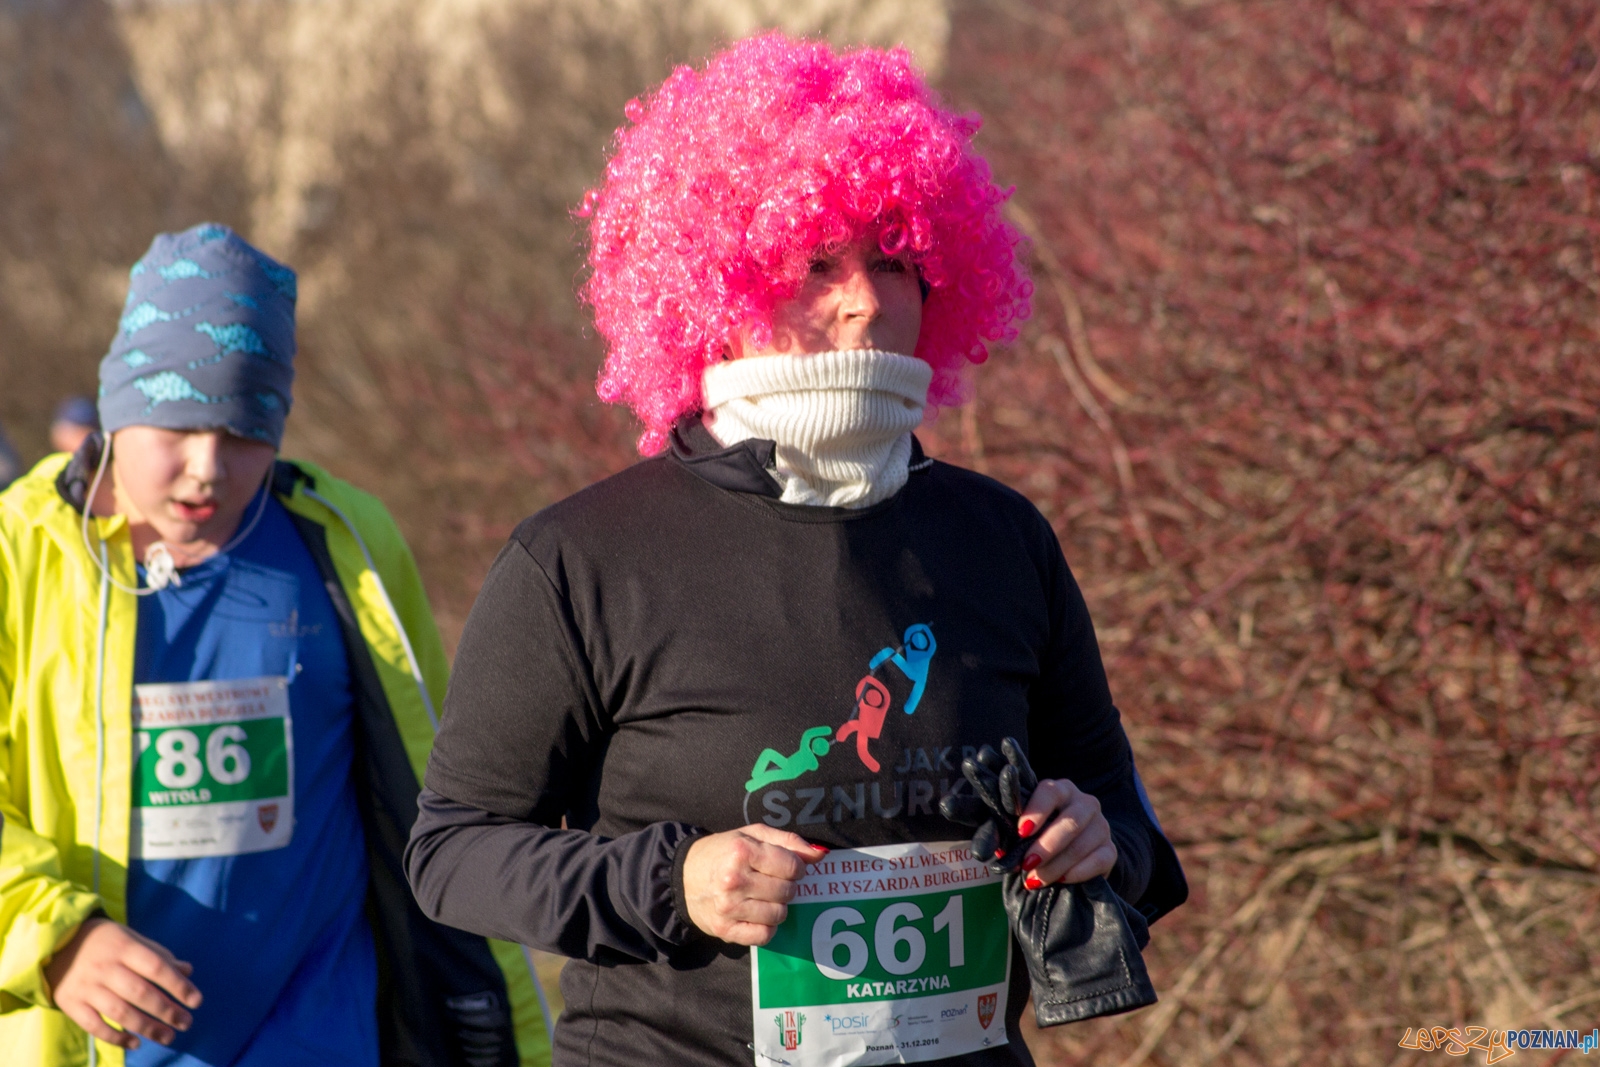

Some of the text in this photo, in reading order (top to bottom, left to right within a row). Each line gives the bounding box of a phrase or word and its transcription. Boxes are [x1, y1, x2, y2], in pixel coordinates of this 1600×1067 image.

[894, 745, 954, 773] JAK
[148, 788, 212, 805] WITOLD
[841, 859, 884, 873] BIEG
[796, 865, 990, 897] IM. RYSZARDA BURGIELA
[811, 894, 965, 980] 661
[846, 975, 951, 998] KATARZYNA
[832, 1012, 870, 1032] posir
[866, 1043, 894, 1052] Poznań
[901, 1038, 939, 1049] 31.12.2016
